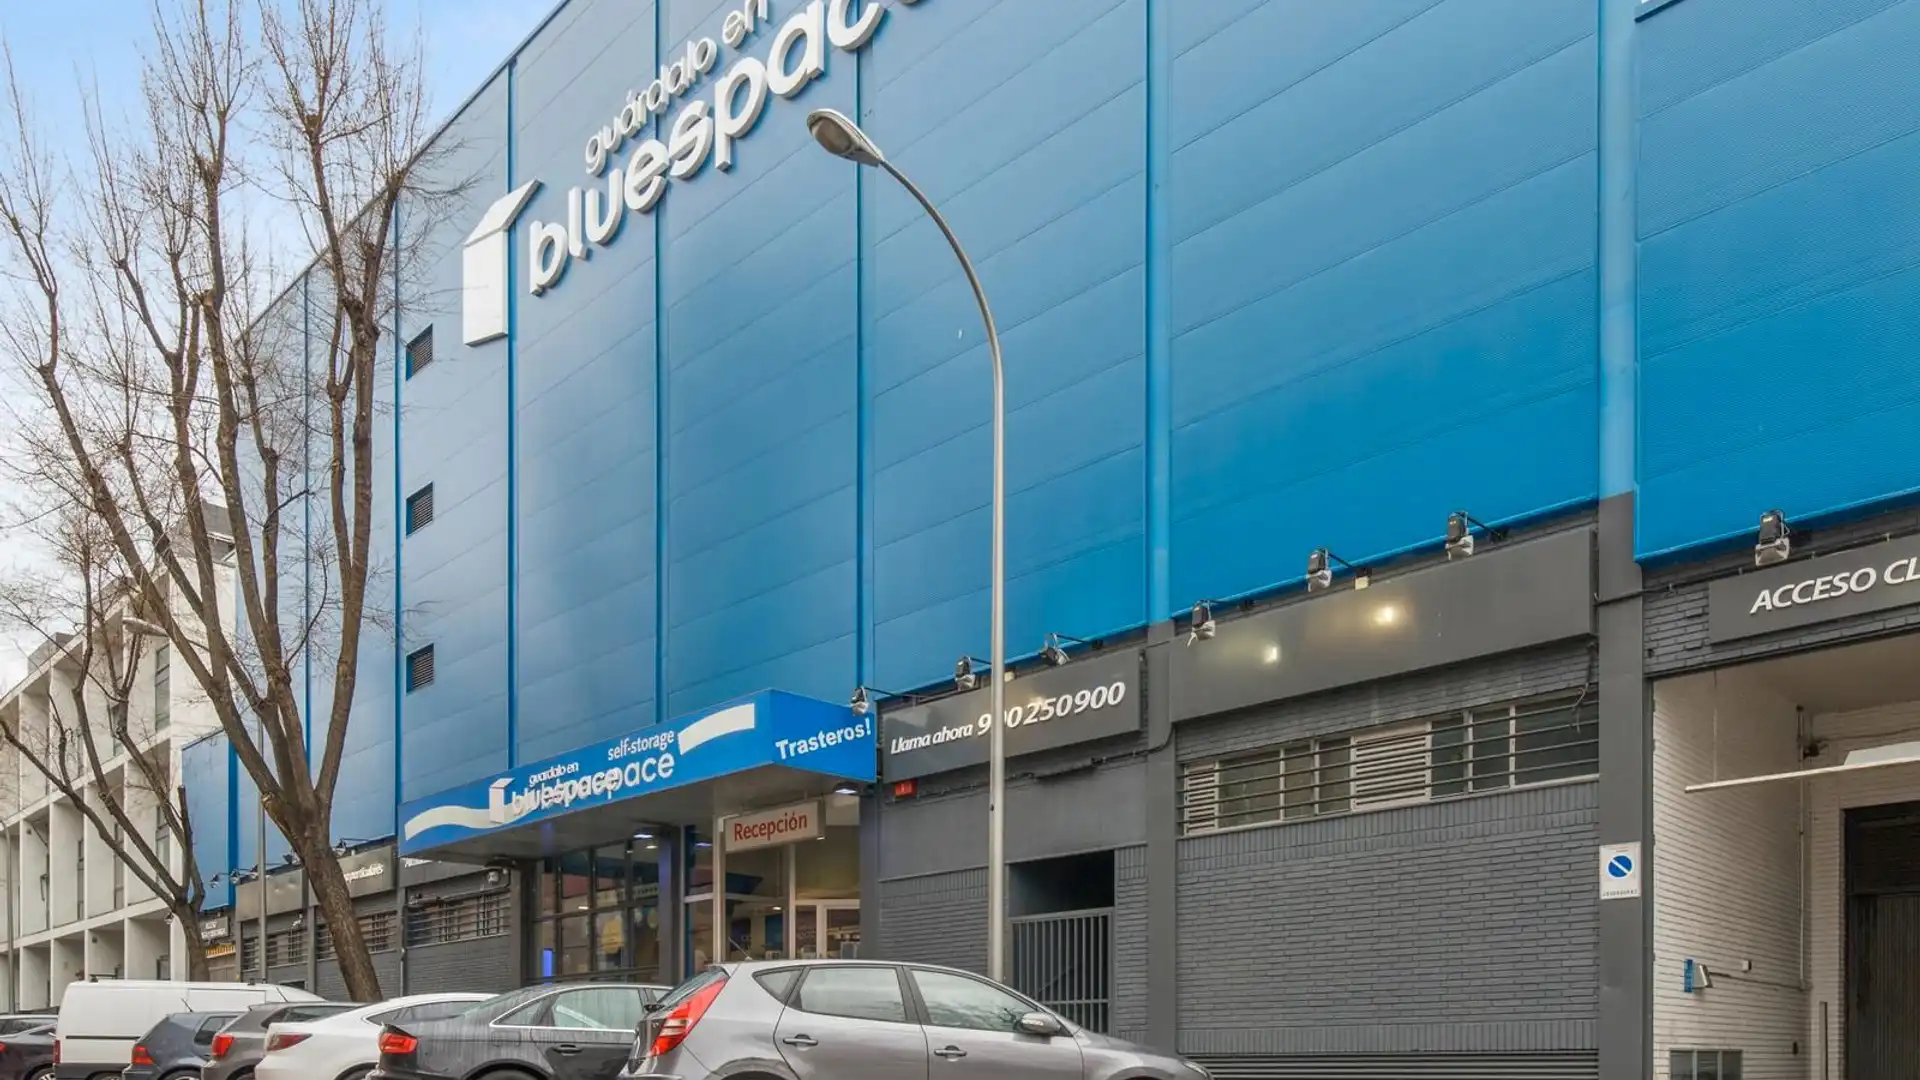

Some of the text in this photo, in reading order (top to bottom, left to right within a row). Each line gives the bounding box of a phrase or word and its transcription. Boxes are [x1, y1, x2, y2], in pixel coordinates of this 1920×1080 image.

[585, 0, 768, 176] guárdalo en
[530, 0, 919, 296] bluespac
[1750, 567, 1877, 614] ACCESO
[775, 718, 871, 760] Trasteros!
[891, 682, 1126, 754] Llama ahora 90250900
[608, 730, 675, 761] self-storage
[734, 812, 807, 841] Recepción
